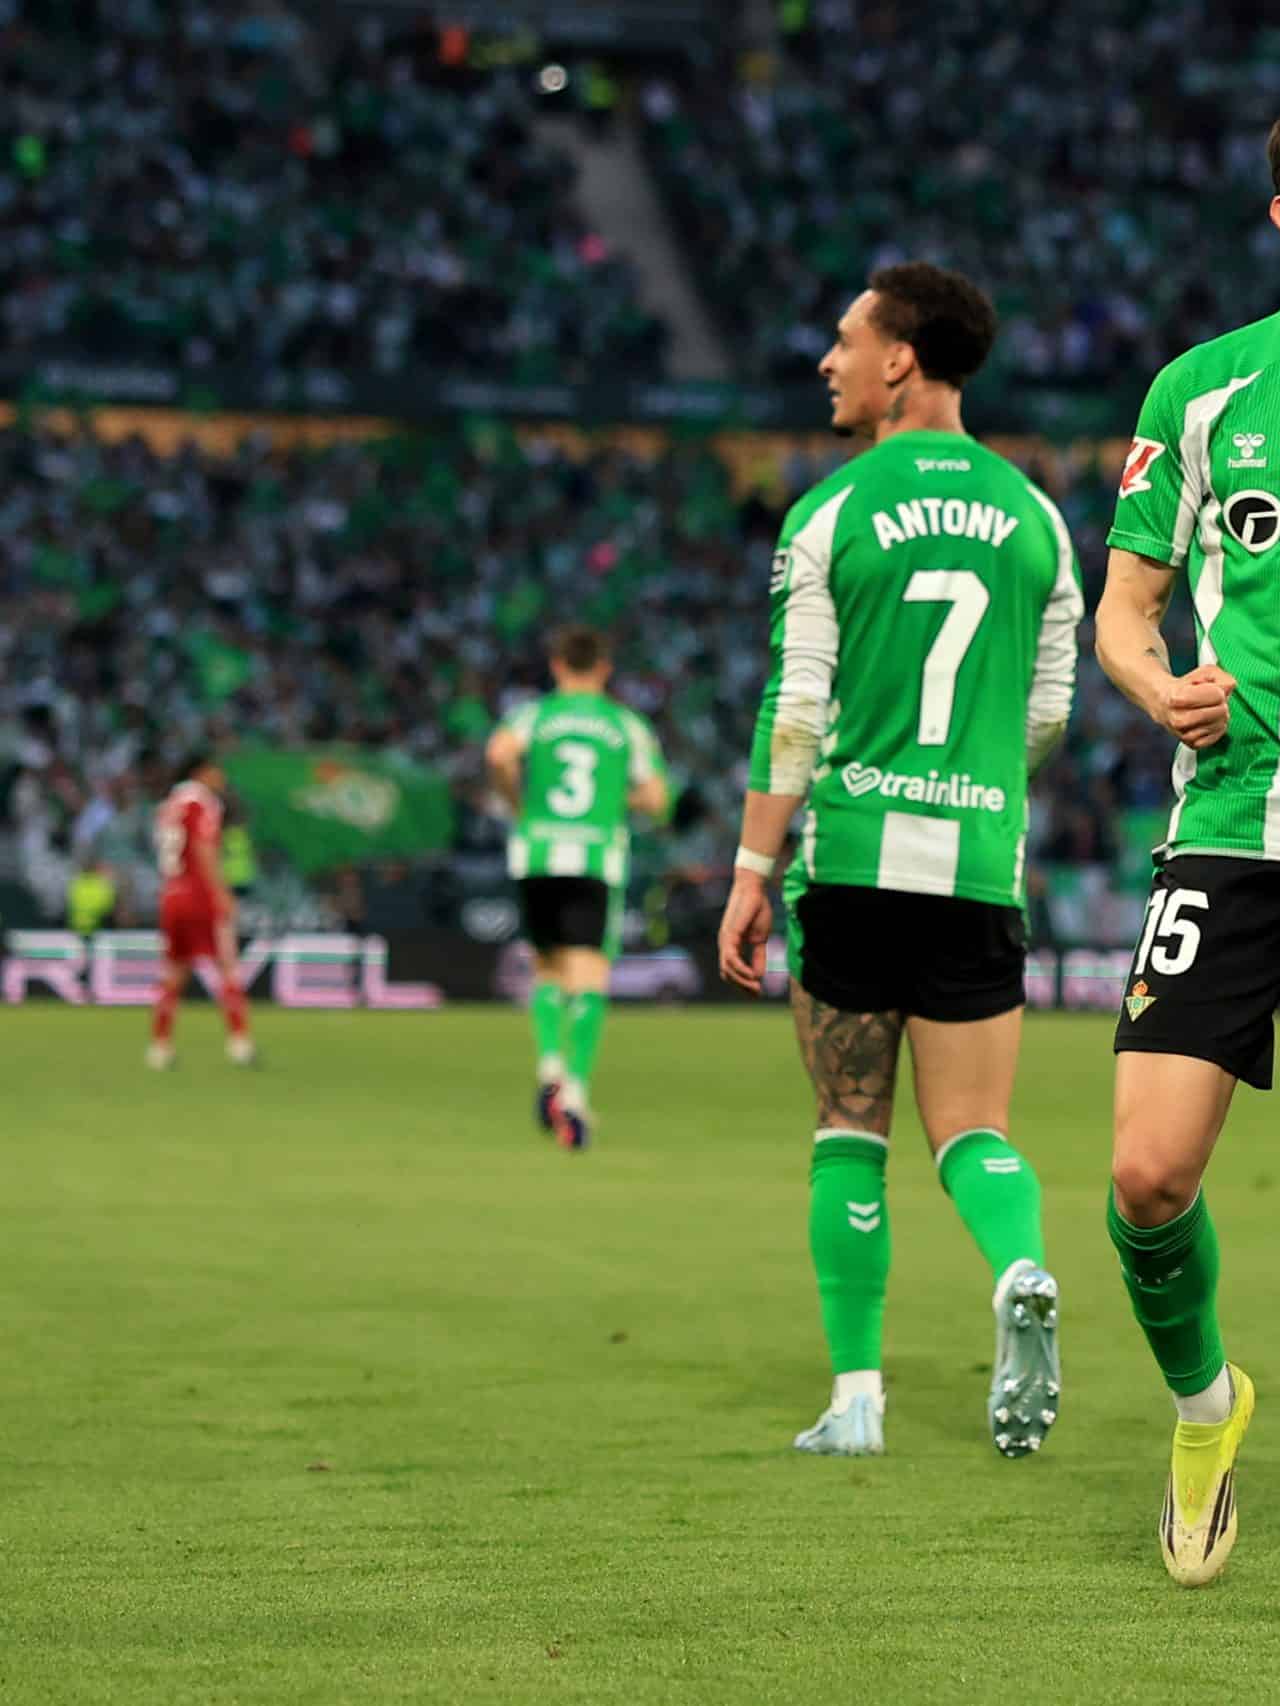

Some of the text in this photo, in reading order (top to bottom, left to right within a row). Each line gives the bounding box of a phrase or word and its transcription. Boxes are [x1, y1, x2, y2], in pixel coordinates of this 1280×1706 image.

[872, 498, 1019, 550] ANTONY
[903, 570, 990, 745] 7
[546, 742, 596, 818] 3
[879, 770, 1005, 811] trainline
[1134, 888, 1209, 975] 15
